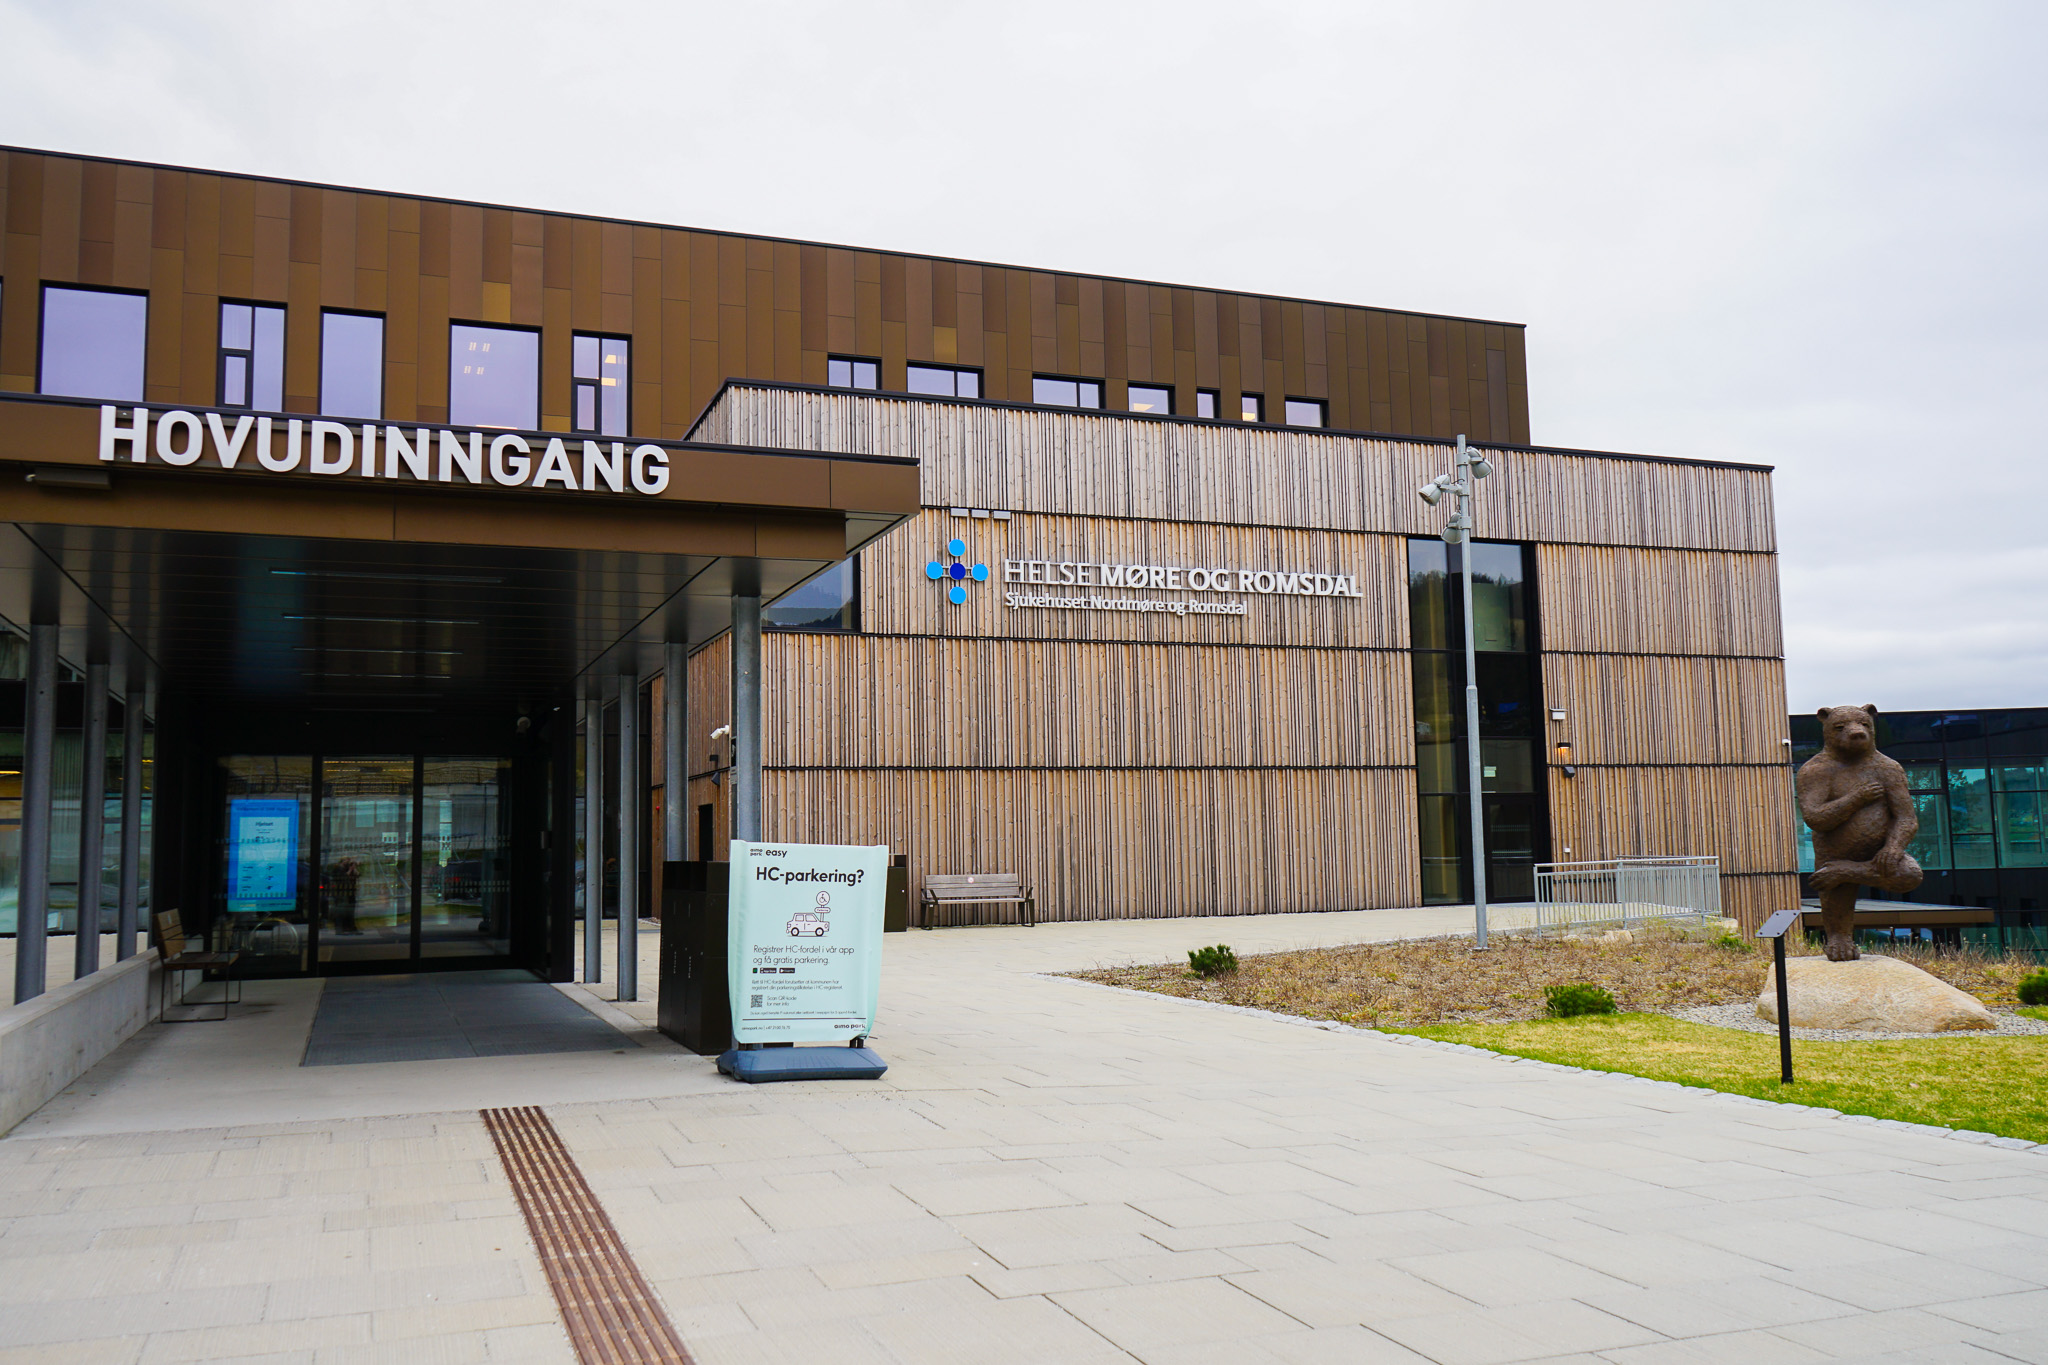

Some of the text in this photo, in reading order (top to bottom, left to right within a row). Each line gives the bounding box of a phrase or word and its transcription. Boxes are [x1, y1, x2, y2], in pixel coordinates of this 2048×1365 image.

[100, 404, 670, 495] HOVUDINNGANG
[1005, 559, 1363, 598] HELSE MØRE OG ROMSDAL
[1005, 591, 1247, 616] Sjukehuset Nordmøre og Romsdal
[765, 848, 788, 858] easy
[756, 866, 865, 887] HC-parkering?
[753, 944, 784, 955] Registrer
[785, 945, 820, 954] HC-fordel
[826, 945, 837, 954] vår
[838, 947, 855, 955] app
[753, 957, 762, 966] og
[764, 955, 772, 964] få
[773, 956, 793, 966] gratis
